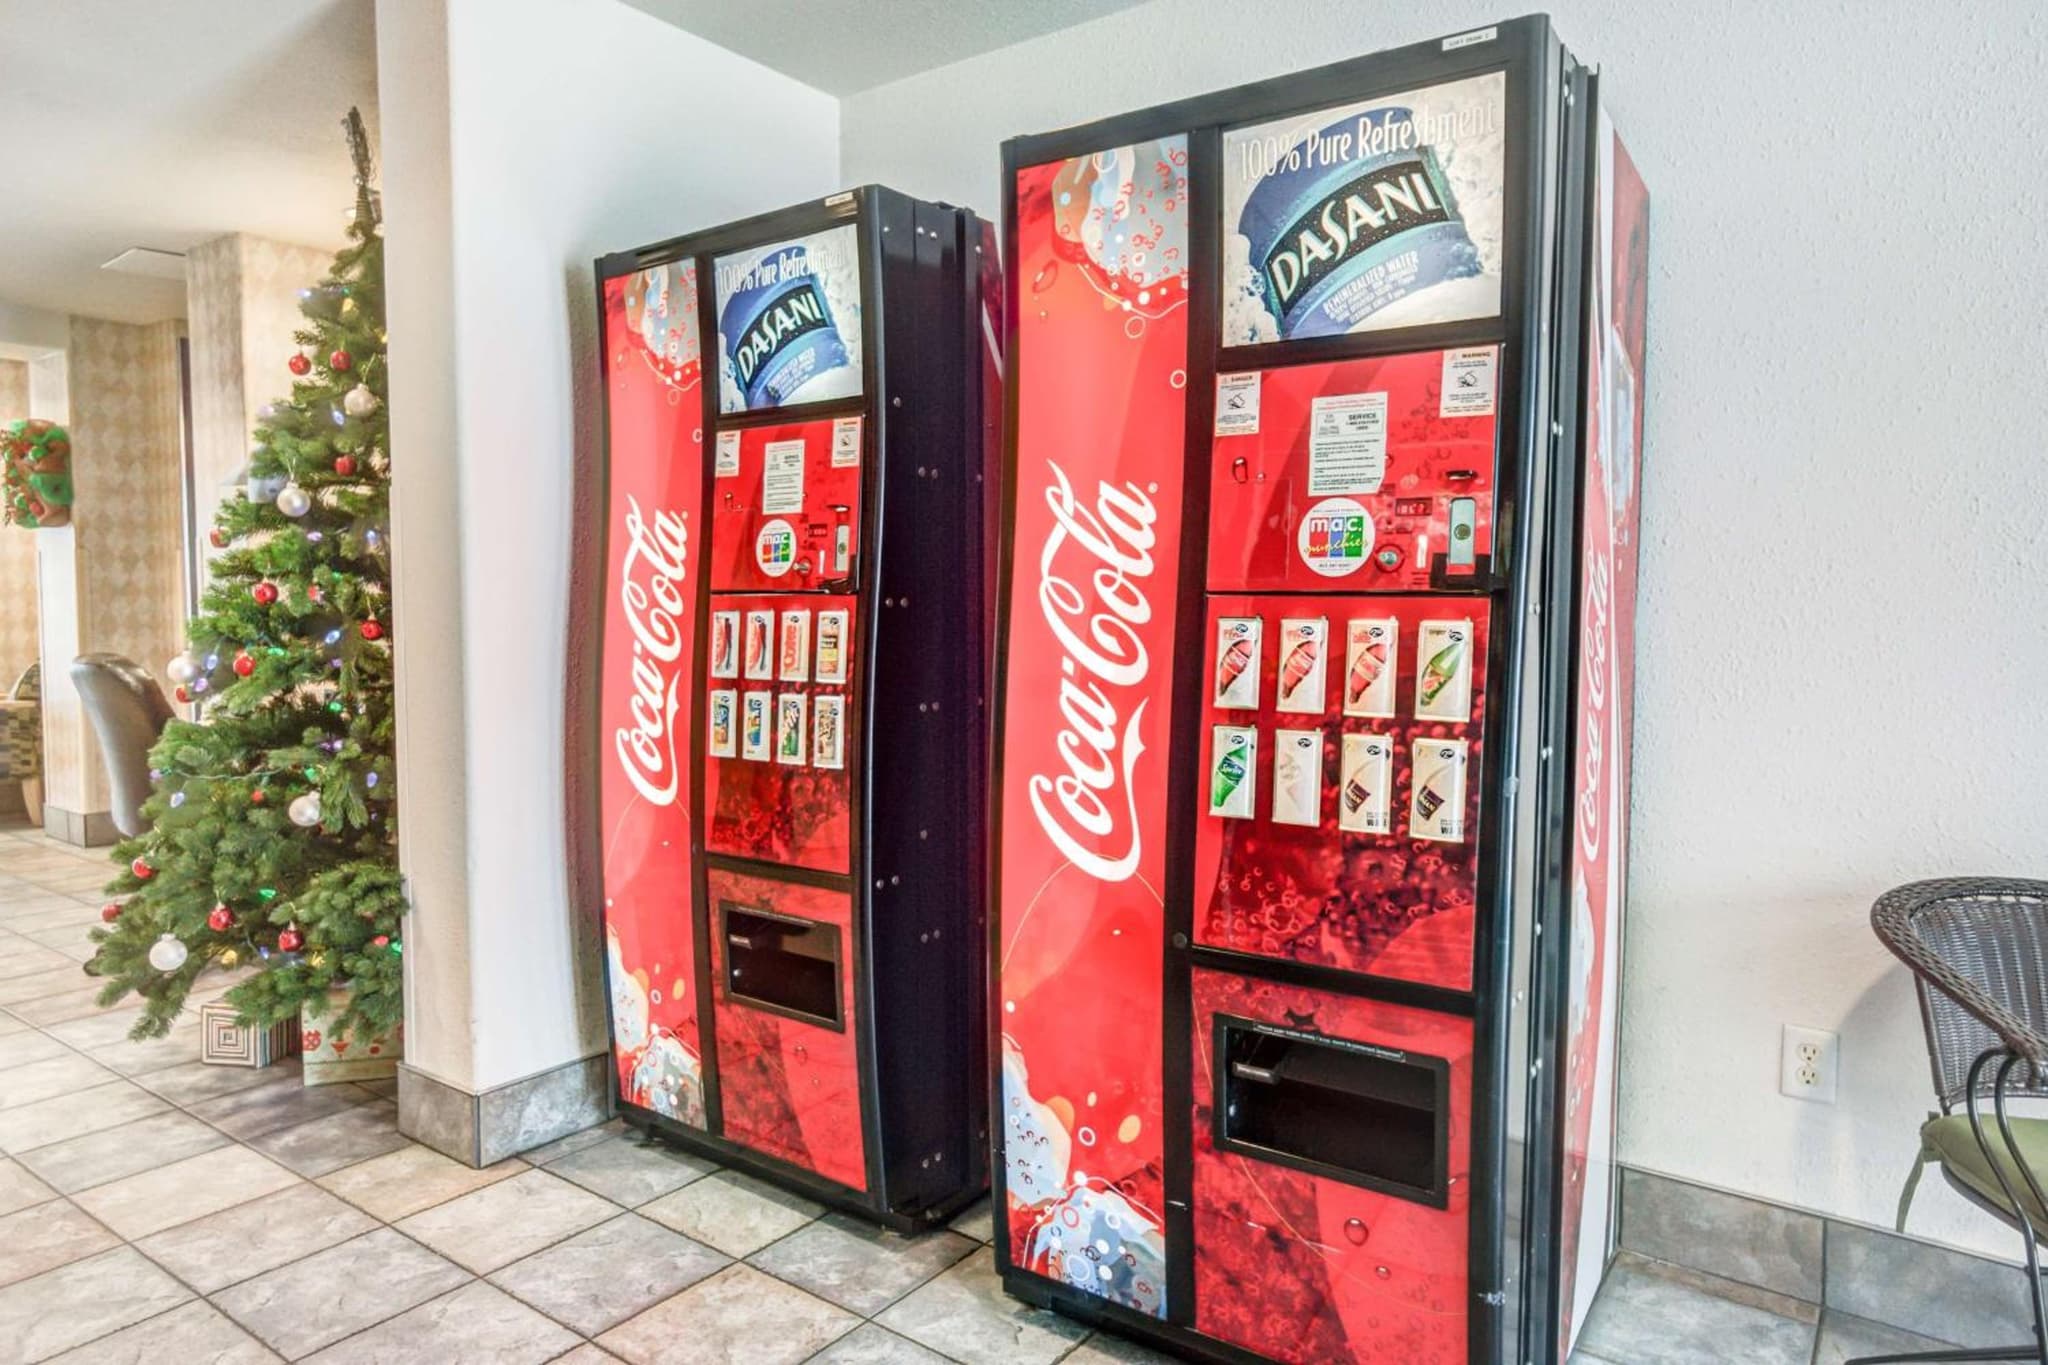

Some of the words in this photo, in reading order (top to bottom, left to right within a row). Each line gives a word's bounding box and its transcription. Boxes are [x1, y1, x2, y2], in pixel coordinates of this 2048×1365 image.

[1241, 129, 1301, 182] 100%
[1307, 129, 1352, 168] Pure
[1358, 100, 1498, 158] Refreshment
[755, 262, 778, 289] Pure
[1271, 171, 1443, 303] DASANI
[1385, 250, 1419, 273] WATER
[736, 292, 823, 383] DASANI
[616, 493, 688, 807] Coca-Cola
[1029, 459, 1158, 882] Coca-Cola
